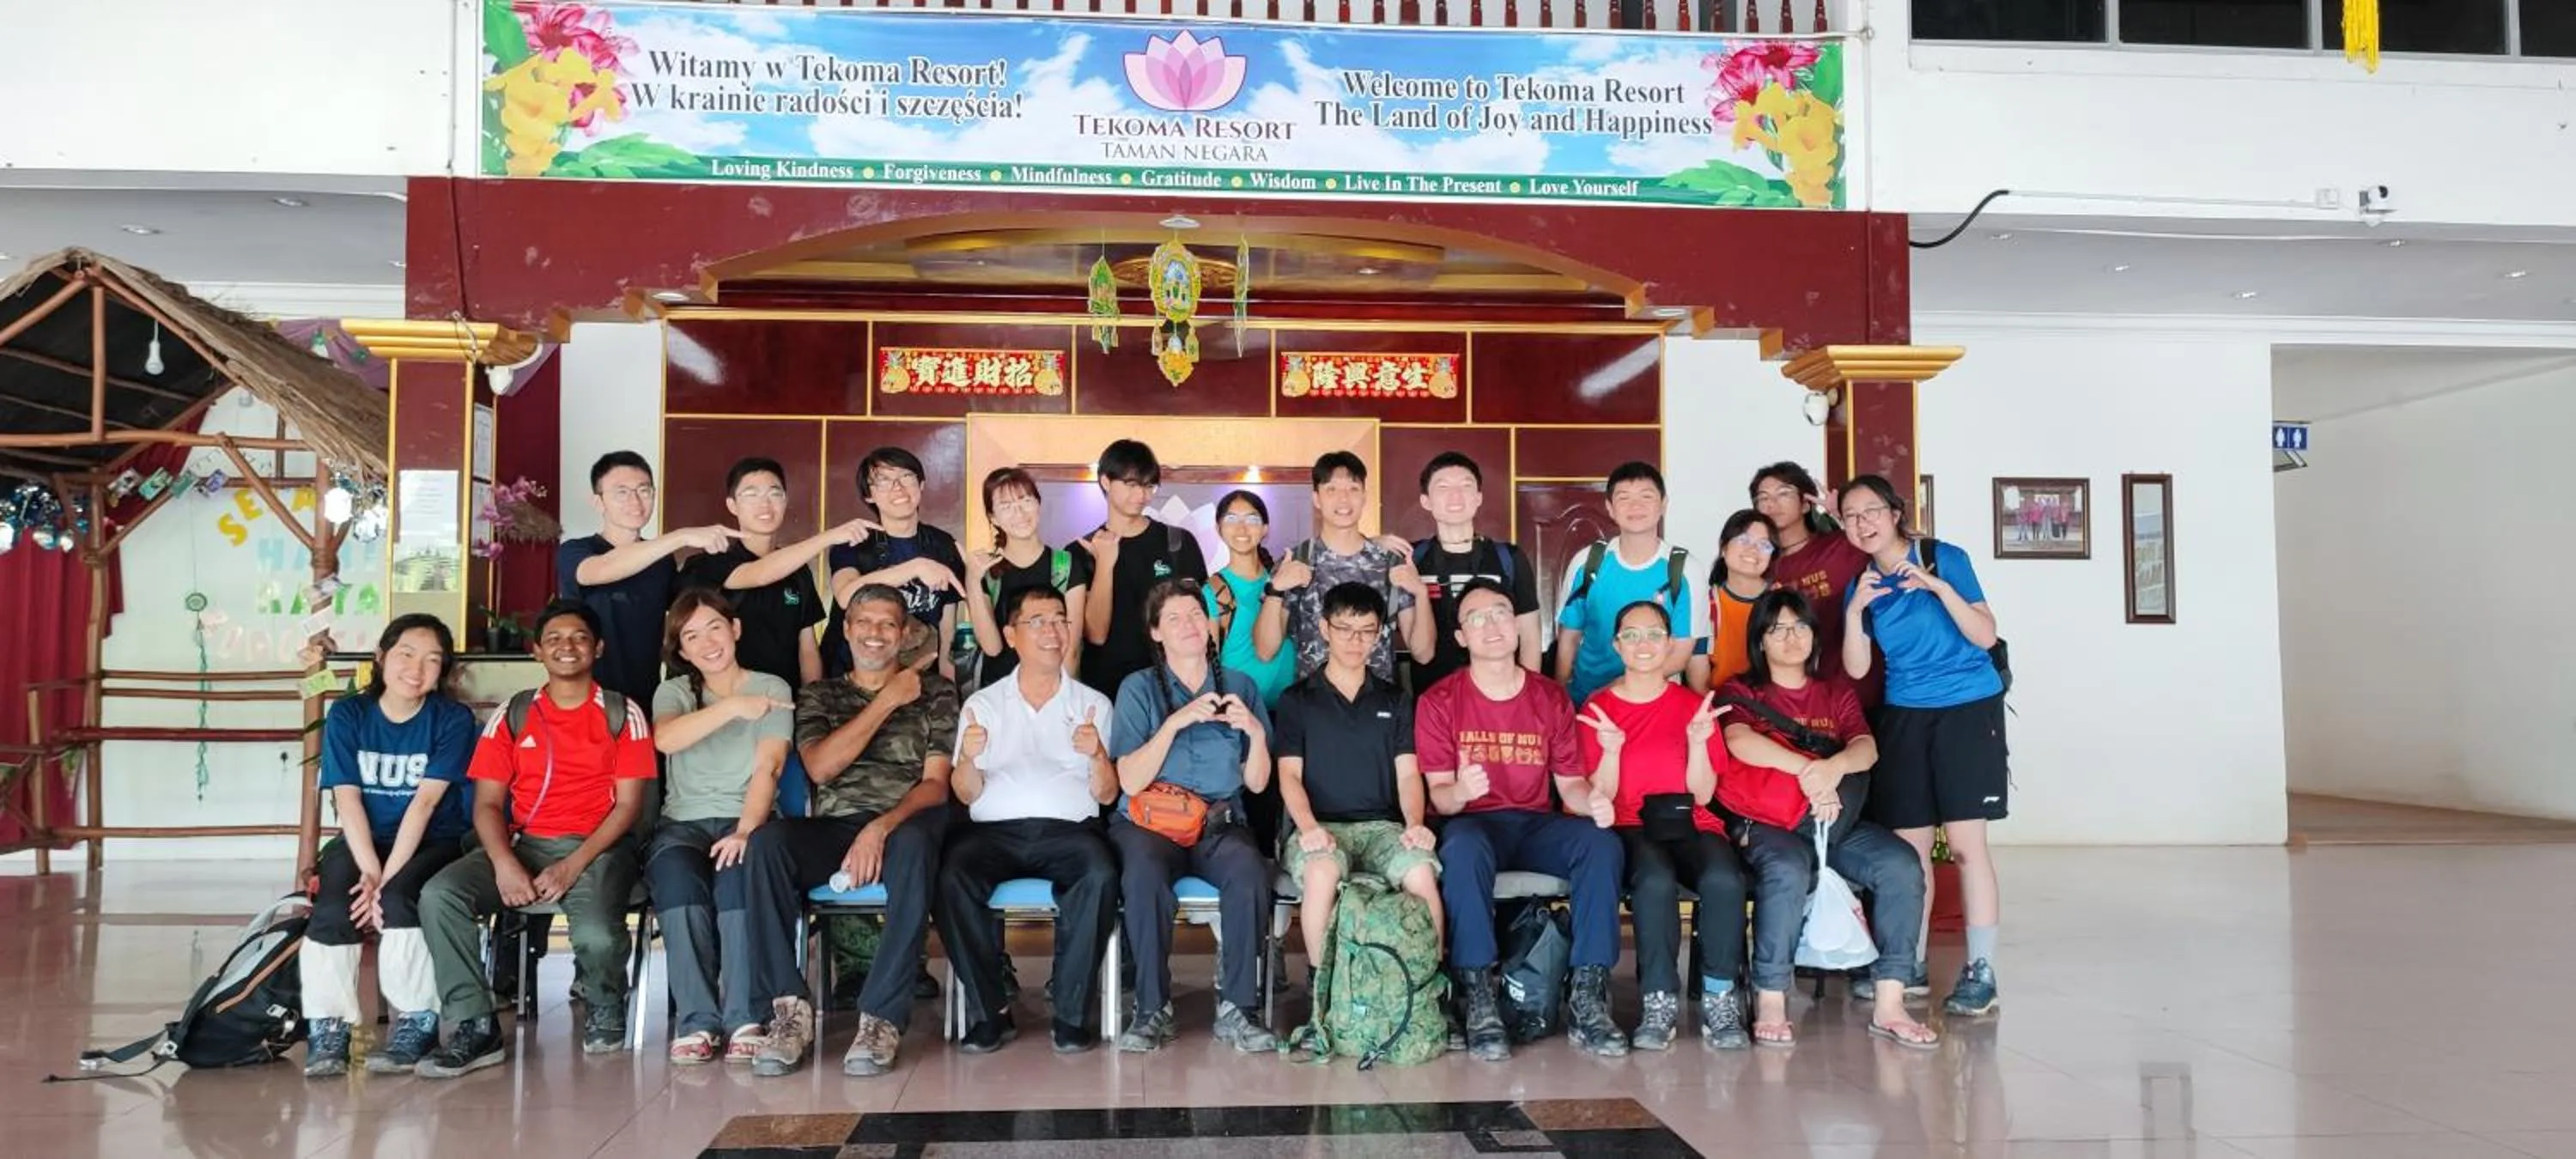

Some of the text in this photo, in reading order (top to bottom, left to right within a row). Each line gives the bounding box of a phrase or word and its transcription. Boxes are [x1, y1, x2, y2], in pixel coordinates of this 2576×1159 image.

[649, 51, 1007, 86] Witamy w Tekoma Resort!
[634, 84, 1024, 123] W krainie radości i szczęścia!
[1343, 71, 1684, 104] Welcome to Tekoma Resort
[1073, 114, 1297, 140] TEKOMA RESORT
[1315, 100, 1713, 140] The Land of Joy and Happiness
[1102, 142, 1268, 162] TAMAN NEGARA
[711, 159, 1638, 197] Loving Kindness Forgiveness Mindfulness Gratitude Wisdom Live In The Present Love Yourself
